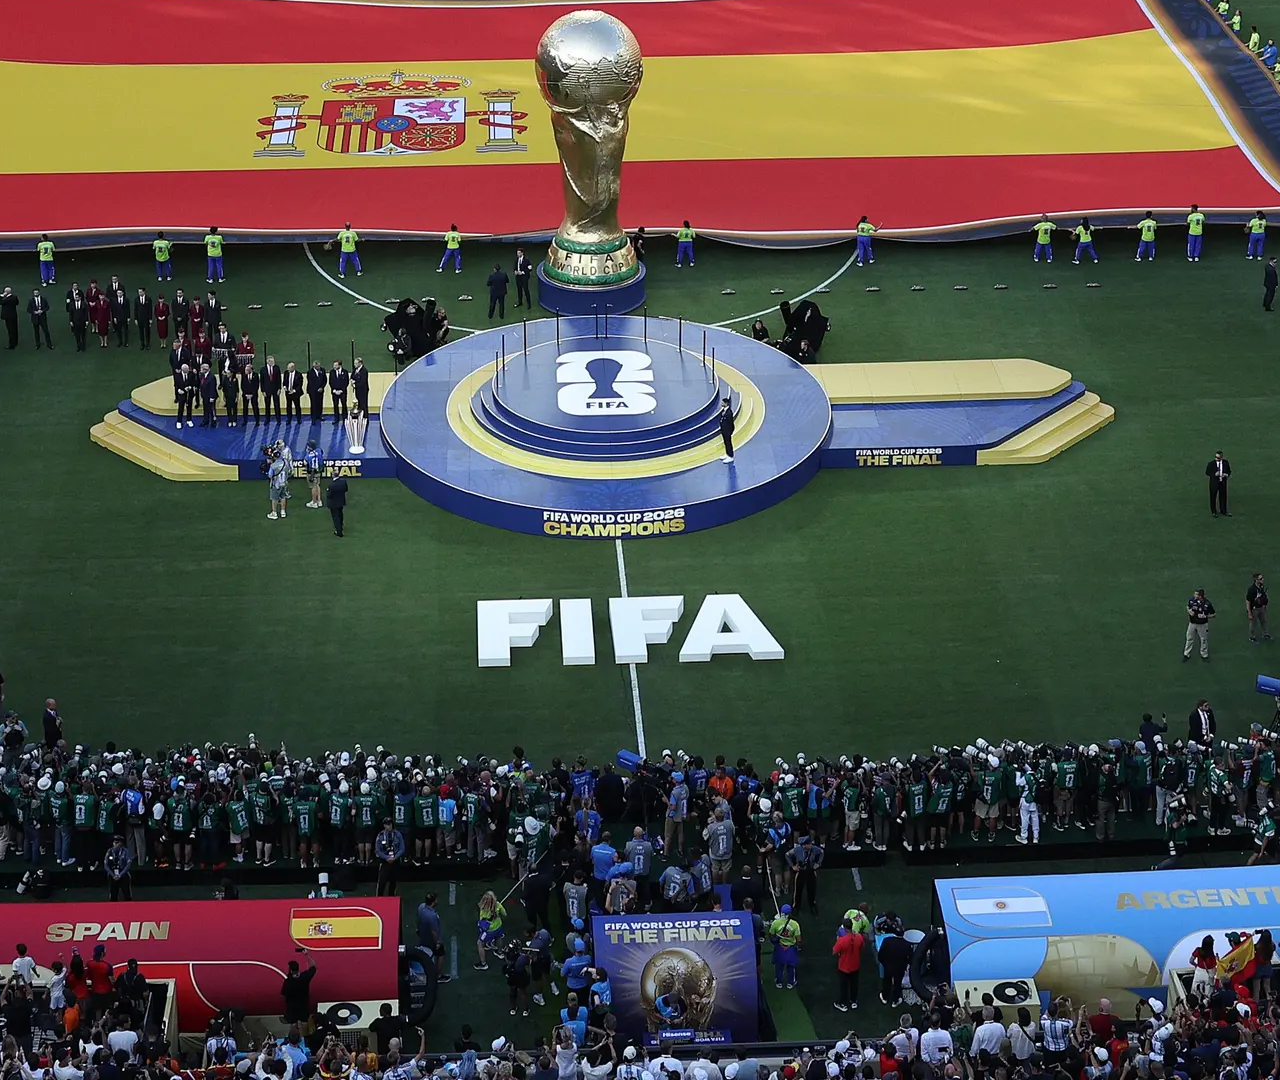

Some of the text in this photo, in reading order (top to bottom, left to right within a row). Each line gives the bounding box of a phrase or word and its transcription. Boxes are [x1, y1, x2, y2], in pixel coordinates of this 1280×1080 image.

[565, 253, 614, 264] FIFA
[557, 262, 625, 276] WORLD CUP
[856, 454, 942, 466] THE FINAL
[544, 508, 685, 523] FIFA WORLD CUP 2026
[543, 519, 685, 537] CHAMPIONS
[477, 594, 784, 667] FIFA
[699, 918, 741, 927] 2026
[46, 921, 170, 942] SPAIN
[605, 926, 742, 944] THE FINAL
